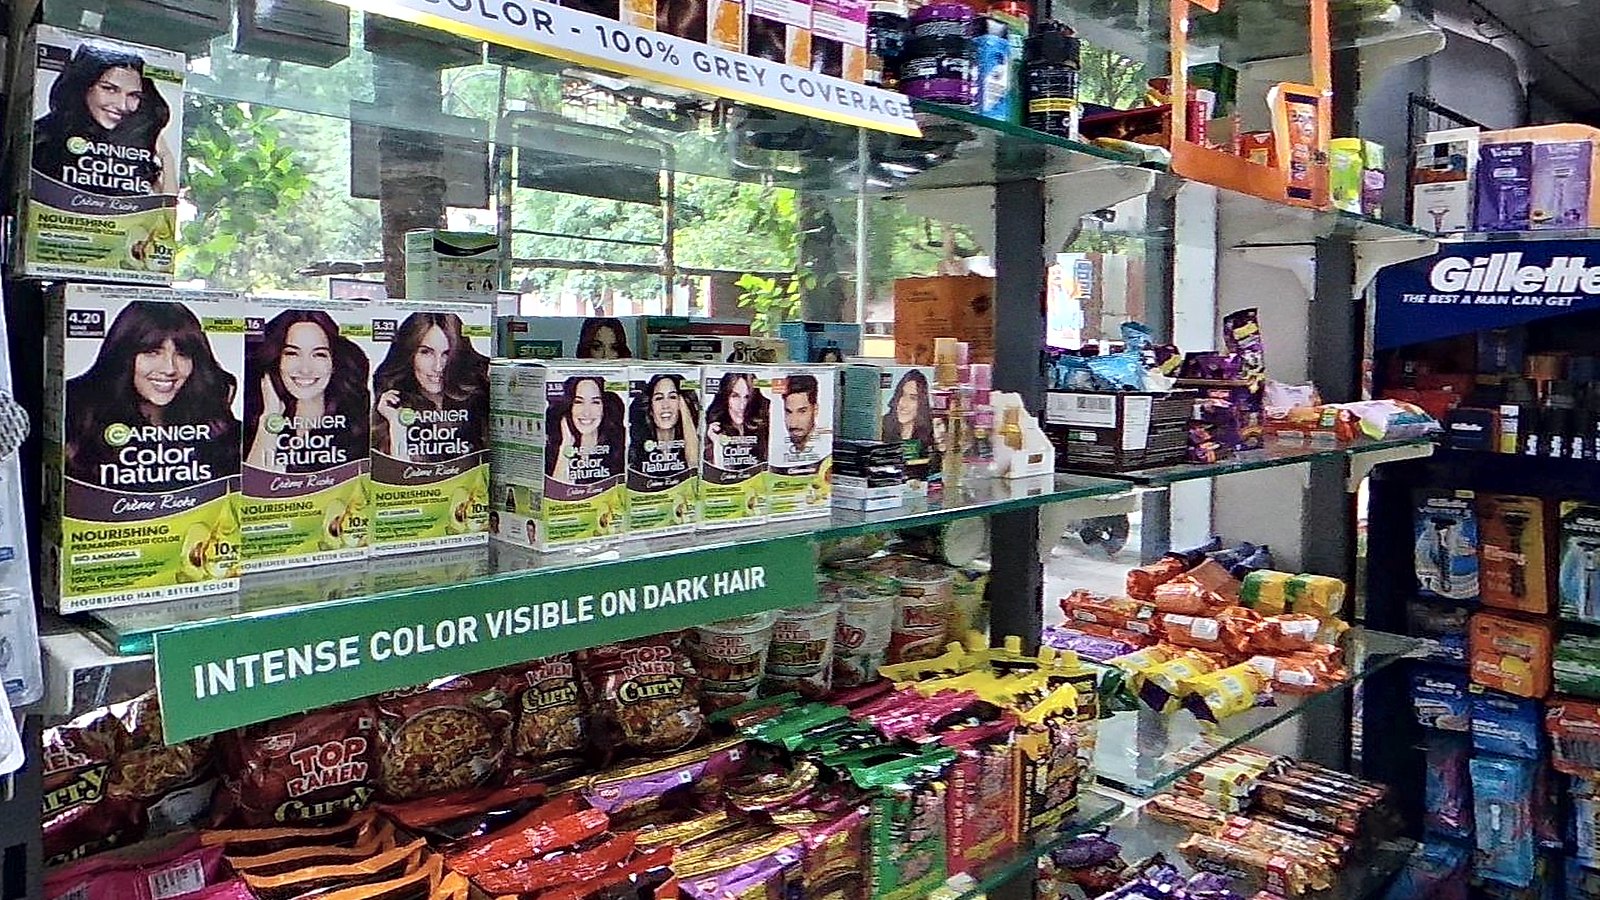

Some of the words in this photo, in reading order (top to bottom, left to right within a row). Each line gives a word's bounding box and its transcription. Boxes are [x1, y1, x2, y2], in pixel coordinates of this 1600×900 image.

[424, 0, 556, 35] OLOR
[595, 25, 680, 66] 100%
[693, 51, 766, 87] GREY
[781, 73, 915, 120] COVERAGE
[66, 136, 151, 162] GARNIER
[78, 155, 139, 177] Color
[62, 165, 153, 193] naturals
[38, 213, 117, 229] NOURISHING
[1402, 294, 1427, 304] THE
[1427, 294, 1460, 304] BEST
[1460, 294, 1472, 305] A
[1474, 295, 1509, 306] MAN
[1511, 295, 1544, 306] CAN
[1545, 296, 1575, 307] GET
[68, 311, 101, 324] 4.20
[265, 414, 347, 434] GARNIER
[399, 407, 469, 427] GARNIER
[104, 423, 211, 447] GARNIER
[276, 432, 334, 451] Color
[407, 425, 458, 442] Color
[119, 443, 195, 467] Color
[649, 451, 679, 464] Color
[722, 445, 752, 458] Color
[569, 456, 603, 470] Color
[100, 462, 212, 486] naturals
[112, 498, 156, 515] Crème
[160, 494, 197, 510] Riche
[375, 488, 442, 501] NOURISHING
[348, 516, 369, 528] 10x
[71, 525, 169, 543] NOURISHING
[193, 635, 361, 699] INTENSE
[369, 616, 478, 662] COLOR
[485, 594, 594, 639] VISIBLE
[600, 586, 636, 618] ON
[643, 575, 709, 609] DARK
[713, 566, 766, 597] HAIR
[620, 646, 672, 665] TOP
[522, 681, 579, 711] Curry
[618, 677, 686, 703] Curry
[290, 736, 368, 776] TOP
[287, 761, 369, 797] RAMEN
[274, 786, 375, 821] Curry
